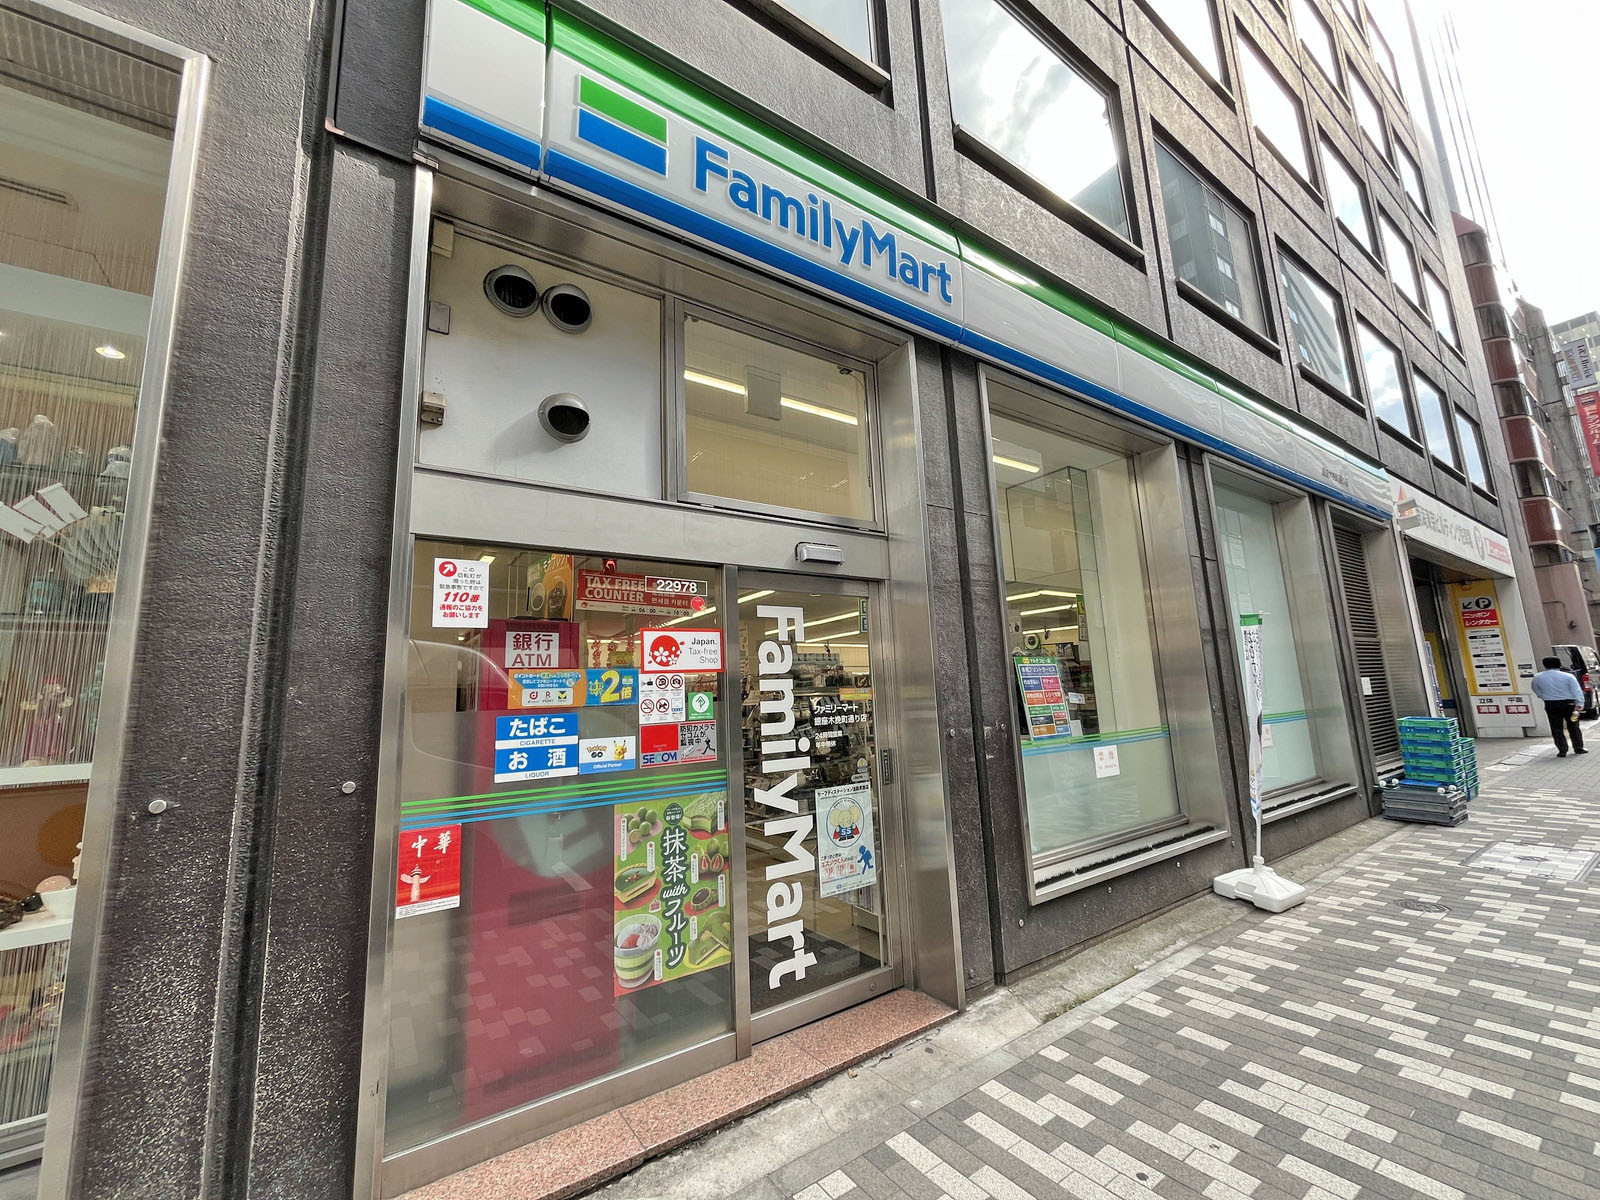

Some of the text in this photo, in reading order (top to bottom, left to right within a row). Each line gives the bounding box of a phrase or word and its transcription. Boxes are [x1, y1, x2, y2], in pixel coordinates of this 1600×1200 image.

[694, 135, 955, 304] FamilyMart
[585, 575, 645, 592] TAX FREE
[656, 579, 698, 594] 22978
[443, 591, 480, 603] 110番
[585, 587, 645, 602] COUNTER
[512, 633, 553, 651] 銀行
[691, 637, 718, 646] Japan.
[688, 647, 718, 655] Tax-free
[512, 653, 551, 667] ATM
[699, 656, 718, 664] Shop
[814, 703, 859, 714] ファミリーマート
[509, 717, 566, 737] たばこ
[680, 723, 716, 733] 防犯カメラで
[680, 731, 706, 739] セコムが
[815, 730, 843, 740] 24時間営業
[519, 738, 556, 747] CIGARETTE
[680, 738, 702, 746] 監視中
[591, 751, 603, 759] GO
[642, 751, 678, 764] SECOM
[525, 771, 550, 779] LIQUOR
[754, 605, 818, 990] FamilyMart
[841, 827, 852, 836] SS
[662, 828, 687, 883] 抹茶
[662, 883, 688, 899] with
[664, 899, 687, 967] フルーツ
